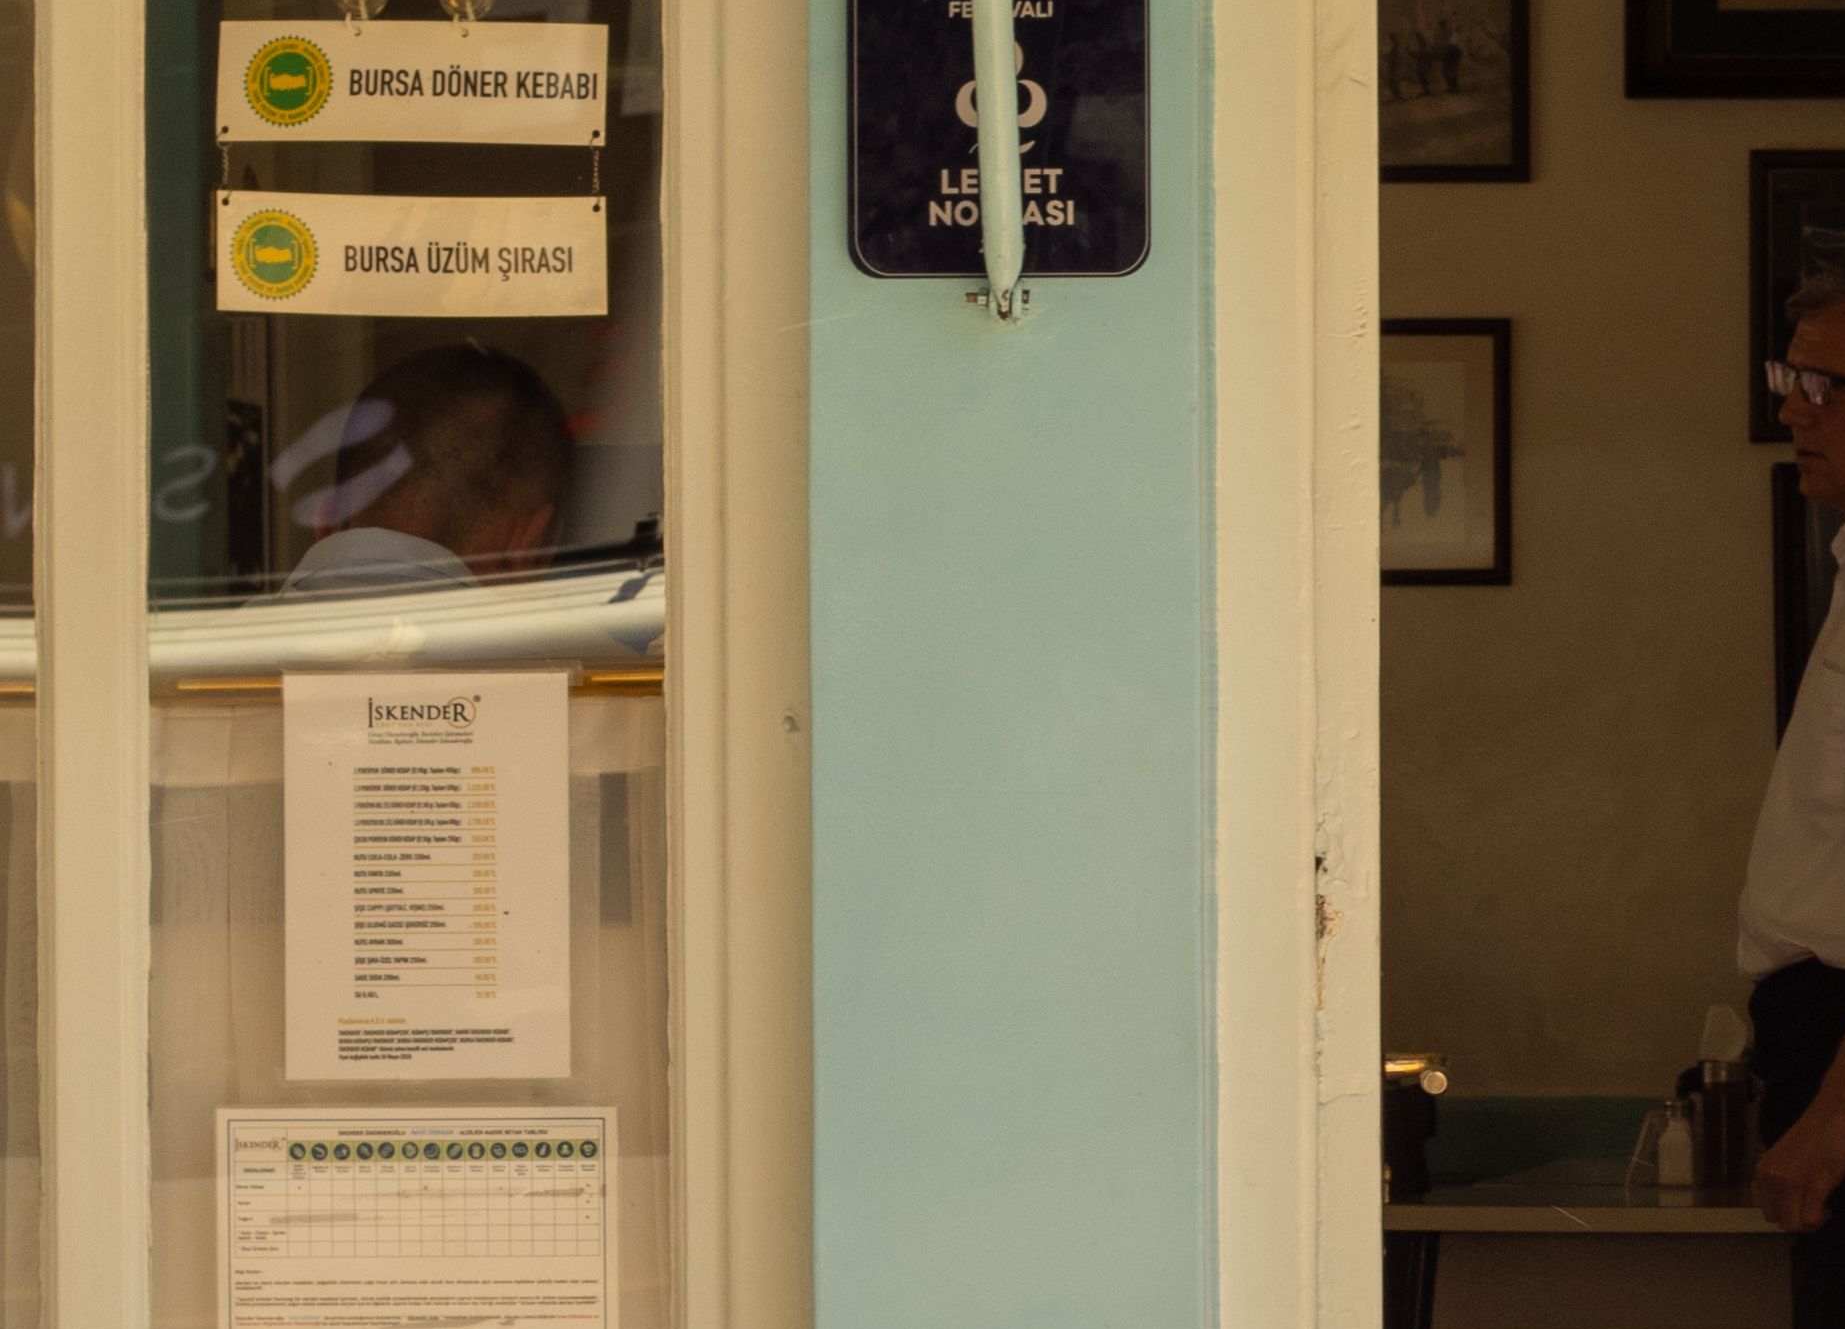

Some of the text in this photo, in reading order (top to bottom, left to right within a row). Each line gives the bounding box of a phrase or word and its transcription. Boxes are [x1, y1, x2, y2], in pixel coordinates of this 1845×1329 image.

[349, 64, 599, 100] BURSA DÖNER KEBABI
[940, 168, 1064, 195] LEET
[928, 199, 1076, 227] NOASI
[344, 241, 574, 282] BURSA ÜZÜM ŞIRASI
